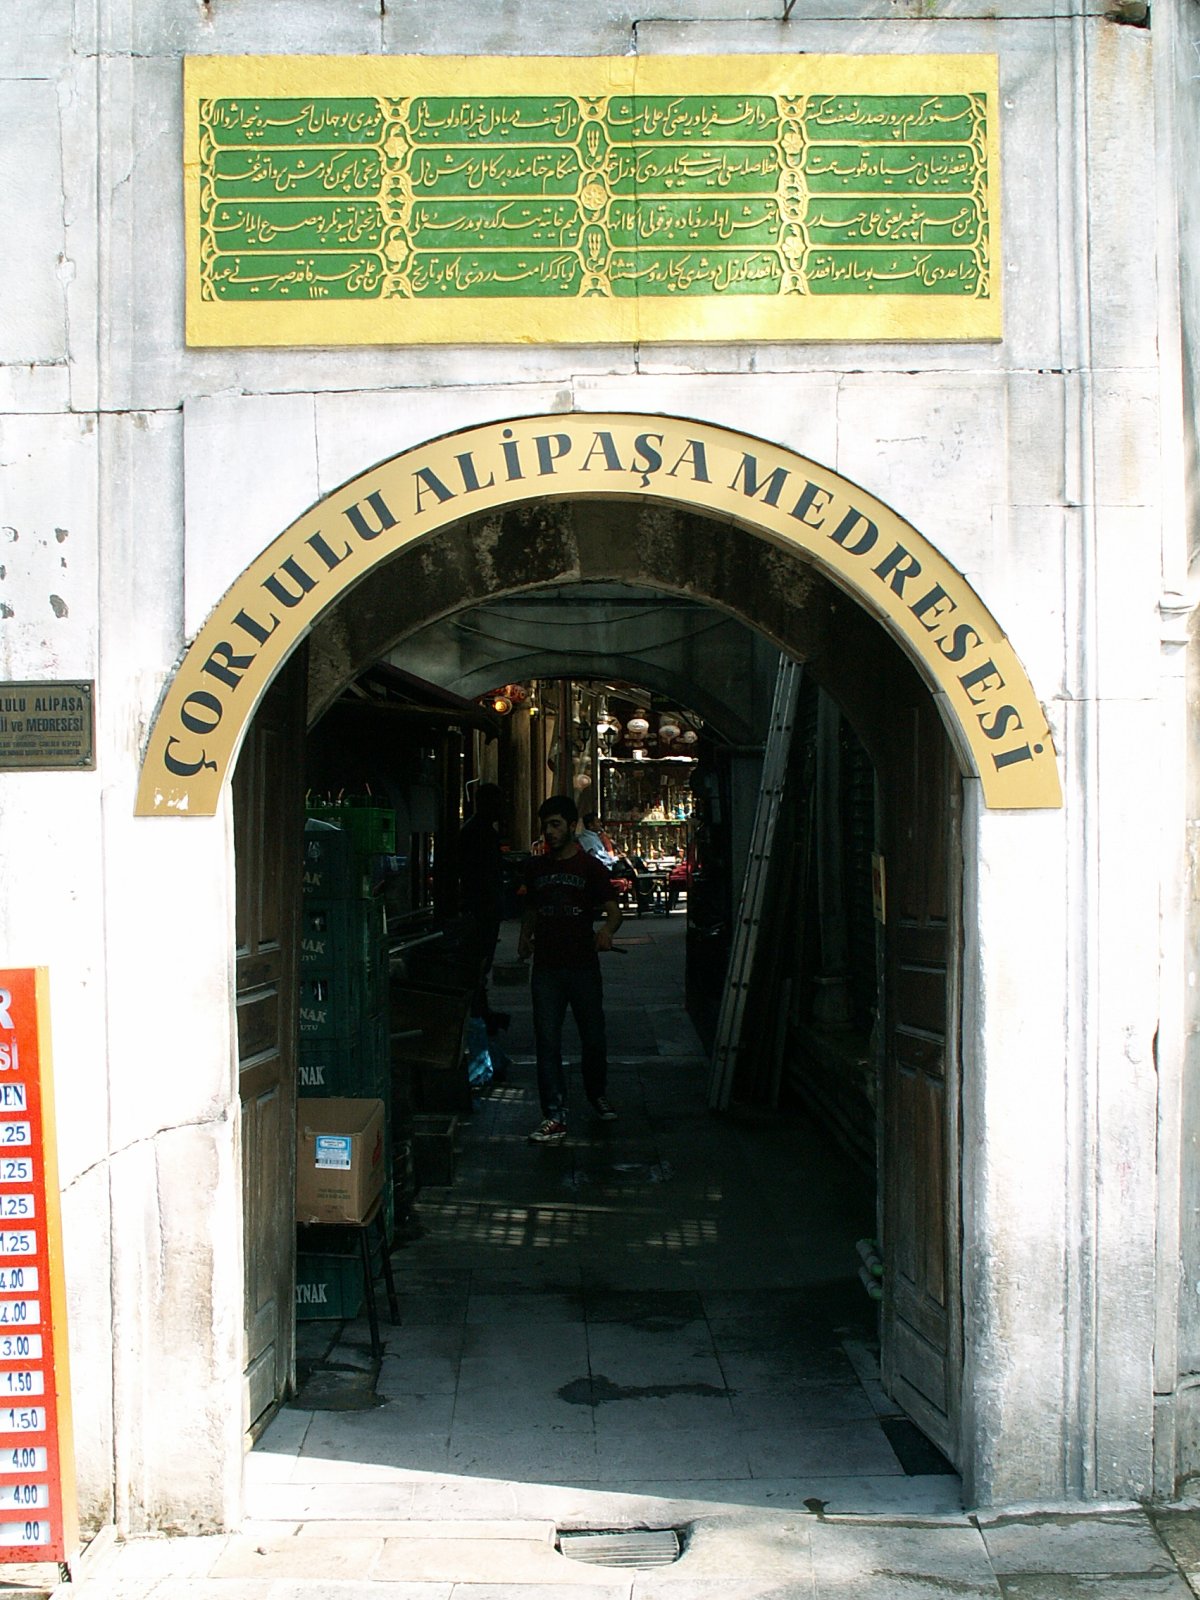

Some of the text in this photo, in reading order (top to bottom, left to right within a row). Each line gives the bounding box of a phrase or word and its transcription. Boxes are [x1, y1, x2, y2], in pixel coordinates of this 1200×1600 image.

[164, 428, 1044, 777] ÇORLULU ALİPAŞA MEDRESESİ
[11, 720, 23, 733] ve
[26, 716, 84, 733] MEDRESESİ
[1, 1301, 27, 1323] 4.00
[2, 1336, 30, 1356] 3.00
[7, 1372, 32, 1392] 1.50
[9, 1408, 38, 1429] 1.50
[12, 1447, 36, 1468] 4.00
[13, 1484, 38, 1505] 4.00
